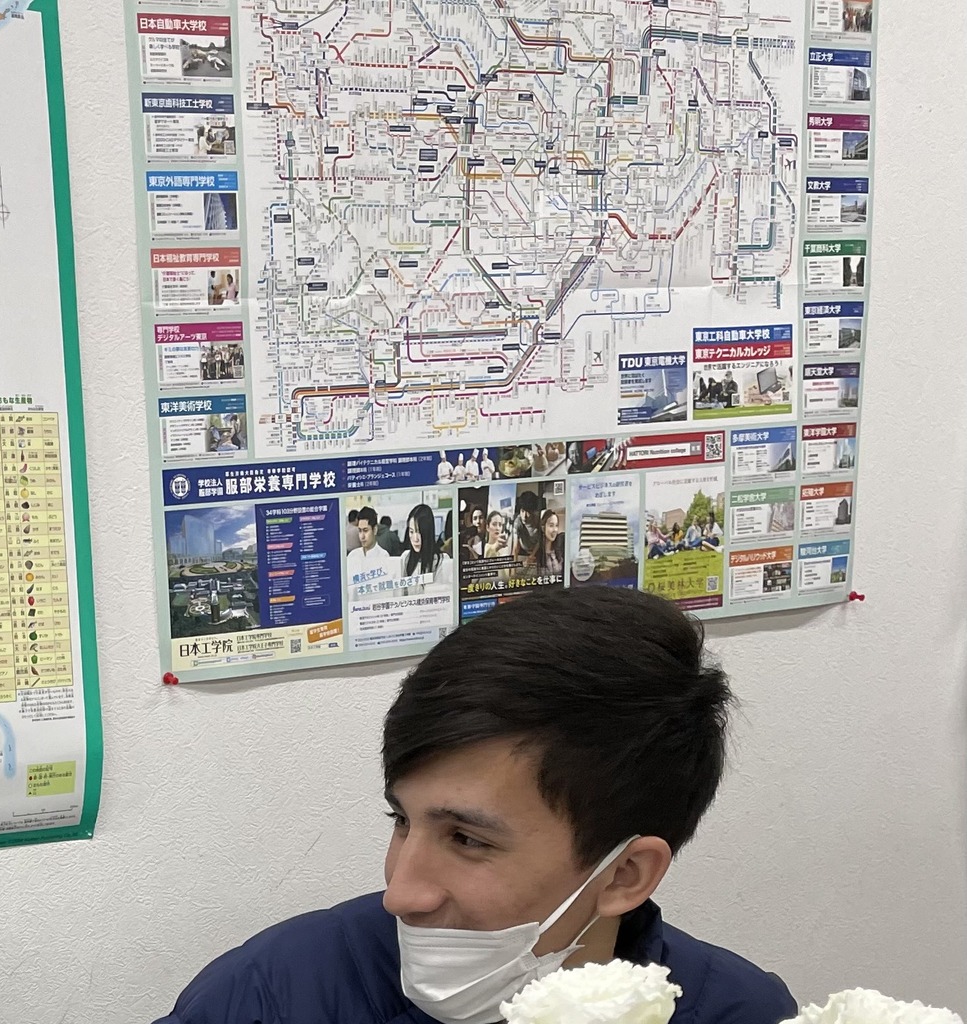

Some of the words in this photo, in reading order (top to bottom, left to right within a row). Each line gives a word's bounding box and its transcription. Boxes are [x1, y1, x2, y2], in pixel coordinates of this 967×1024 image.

[139, 18, 207, 32] 日本自動車大学校
[808, 49, 834, 63] 立正大学
[144, 98, 213, 109] 新東京歯科技工士学校
[808, 115, 834, 128] 秀明大学
[148, 175, 215, 188] 東京外語専門学校
[806, 179, 832, 192] 文教大学
[803, 242, 842, 255] 千葉商科大学
[153, 252, 220, 264] 日本福祉教育専門学校
[804, 305, 841, 315] 東京経済大学
[156, 325, 180, 333] 専門学校
[157, 333, 208, 342] デジタルアーツ東京
[695, 329, 770, 342] 東京工科自動車大学校
[695, 346, 771, 359] 東京テクニカルカレッジ
[621, 357, 643, 369] TDU
[644, 355, 686, 367] 東京電機大学
[804, 367, 835, 377] 順天堂大学
[161, 400, 212, 413] 東洋美術学校
[732, 431, 770, 443] 多摩美術大学
[803, 427, 838, 437] 東洋学園大学
[197, 478, 223, 488] 学校法人
[225, 471, 336, 495] 服部栄養専門学校
[199, 488, 224, 497] 服部学園
[731, 492, 767, 504] 二松学舎大学
[801, 487, 825, 497] 拓殖大学
[800, 545, 827, 556] 駿河台大学
[730, 551, 777, 563] デジタルハリウッド大学
[461, 574, 563, 593] 一度きりの人生。好きなことを仕事に
[657, 577, 705, 592] 桜美林大学
[179, 639, 234, 657] 日本工学院
